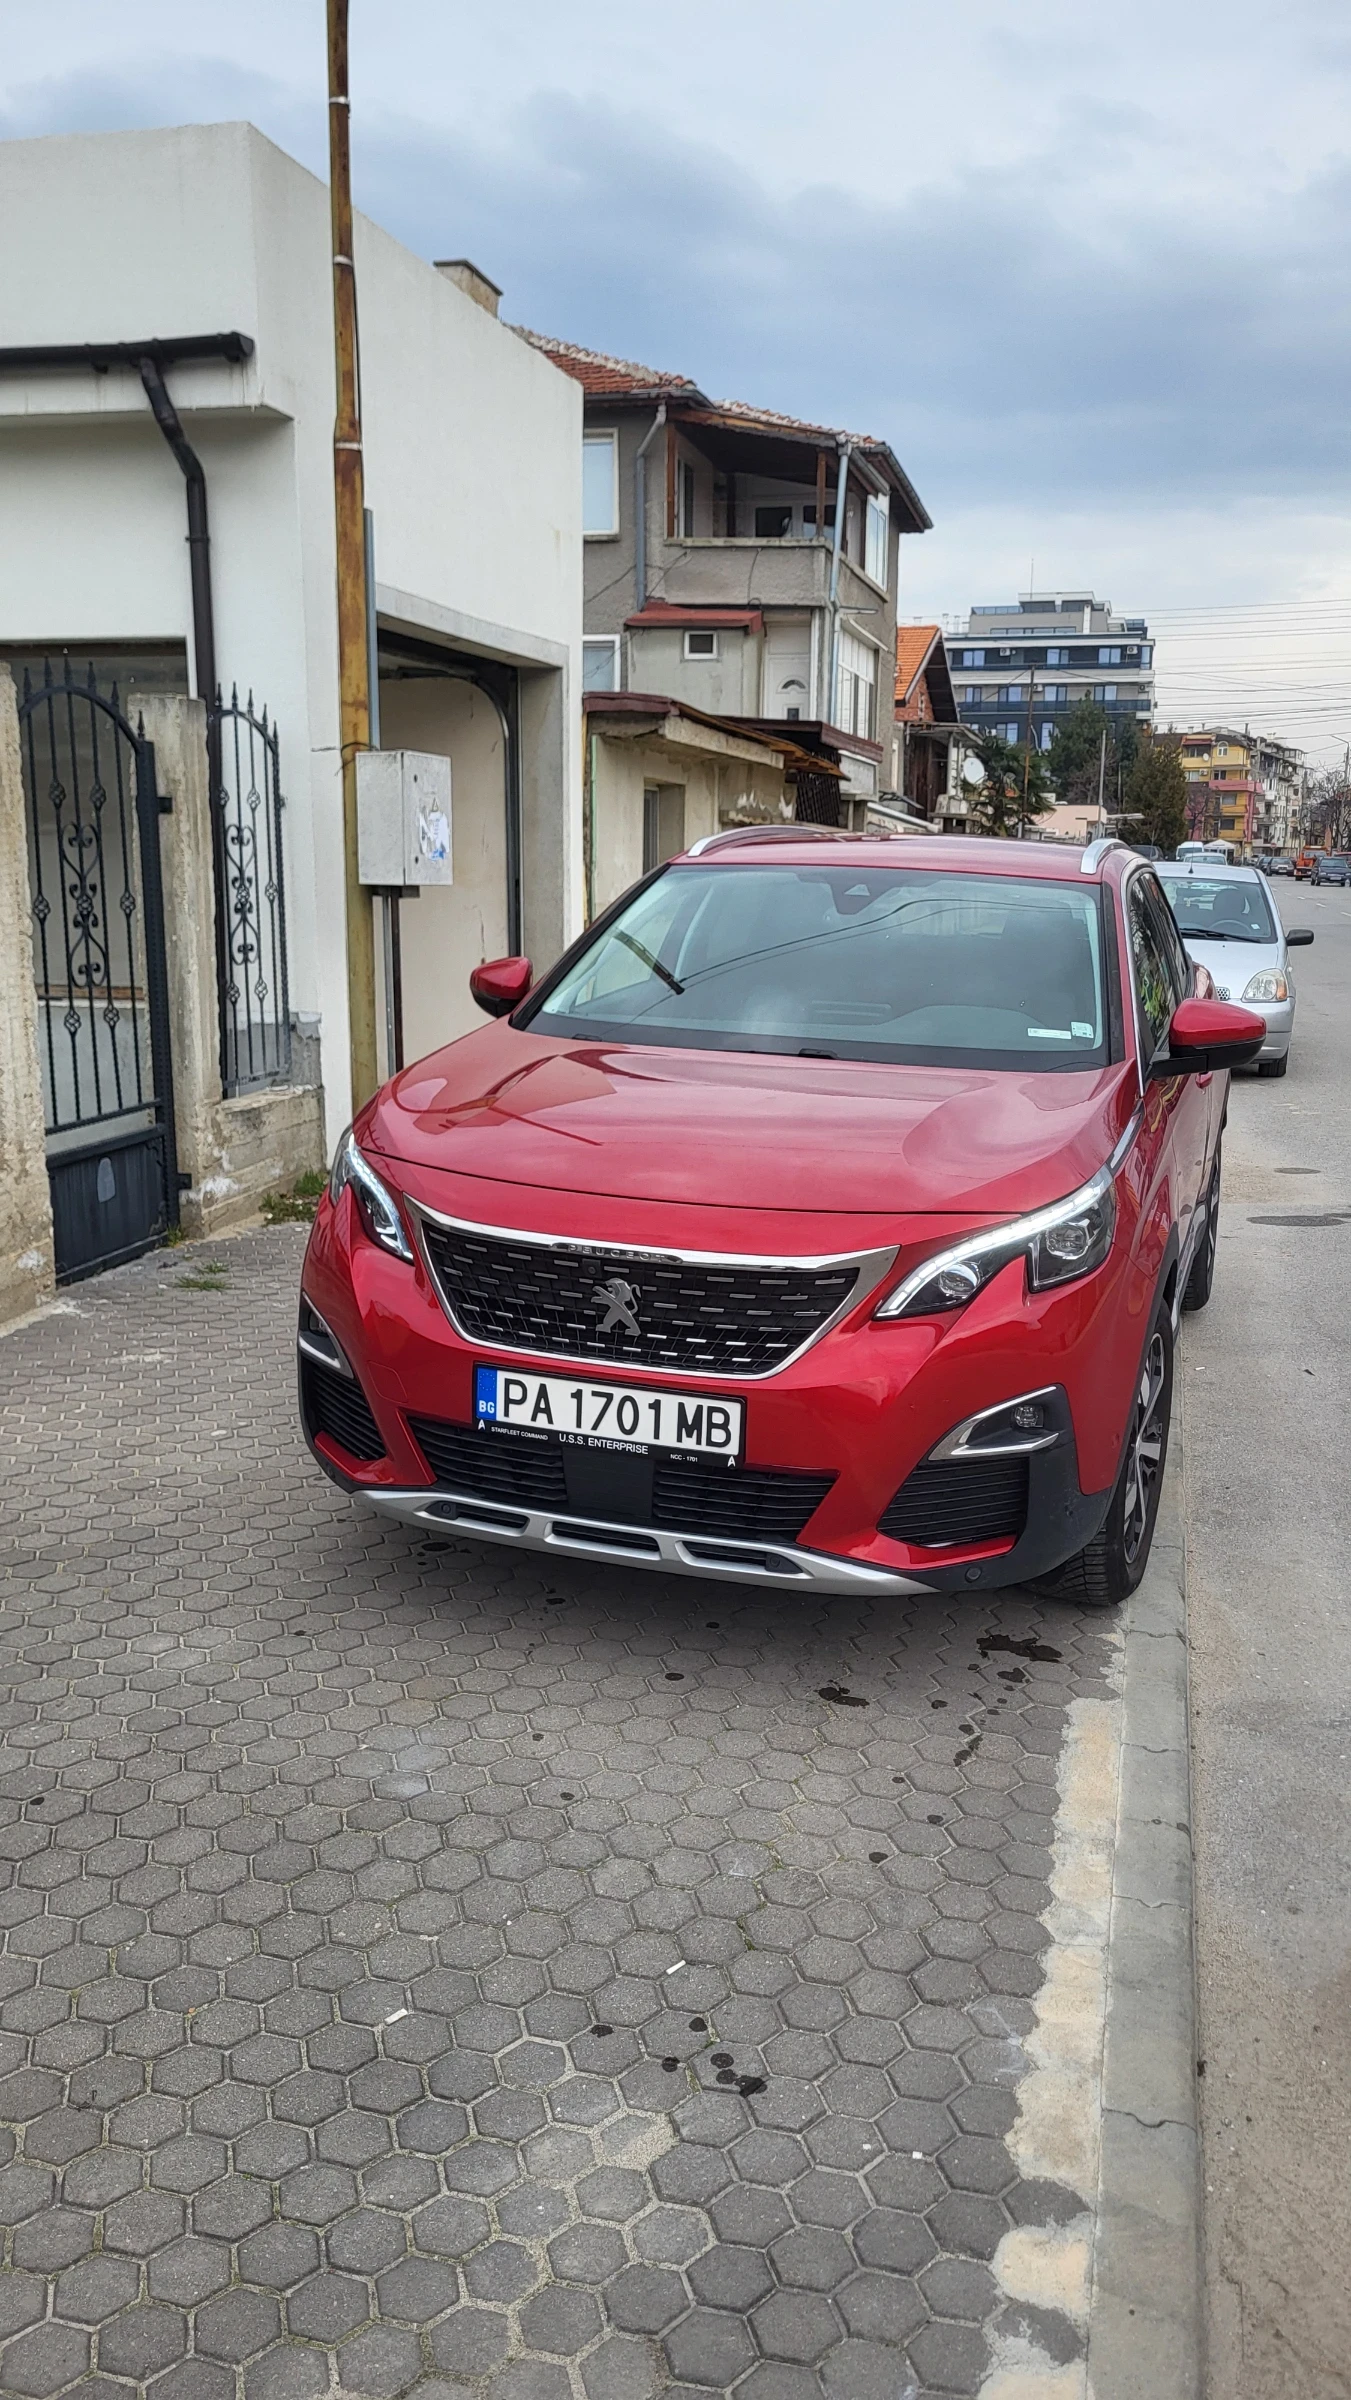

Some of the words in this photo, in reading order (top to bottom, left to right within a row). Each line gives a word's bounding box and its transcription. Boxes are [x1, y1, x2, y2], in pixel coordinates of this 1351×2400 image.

[567, 1244, 666, 1263] PEUGEOT
[479, 1400, 495, 1414] BG
[504, 1378, 554, 1425] PA
[570, 1388, 662, 1440] 1701
[676, 1401, 732, 1448] MB
[491, 1426, 520, 1436] STARFLEET
[520, 1430, 549, 1441] COMMAND
[559, 1433, 586, 1446] U.S.S.
[588, 1437, 649, 1455] ENTERPRISE
[686, 1455, 698, 1463] 1701
